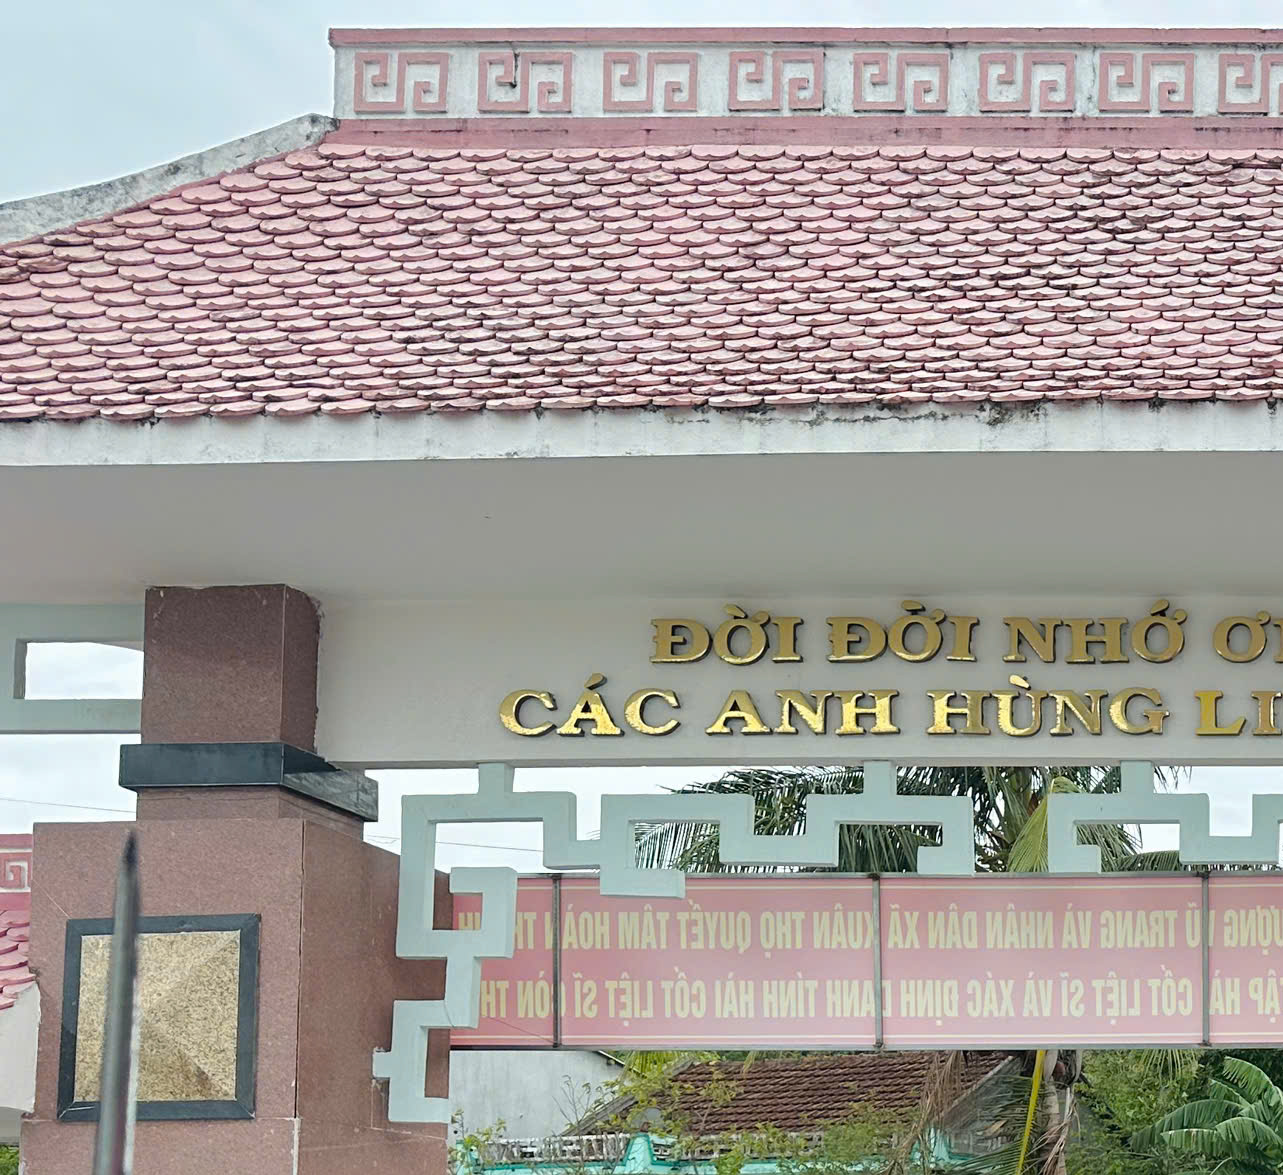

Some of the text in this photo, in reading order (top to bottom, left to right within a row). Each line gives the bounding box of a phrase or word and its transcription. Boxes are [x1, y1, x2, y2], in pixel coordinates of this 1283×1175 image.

[650, 604, 804, 666] ĐỜI
[827, 600, 980, 664] ĐỜI
[1002, 599, 1188, 664] NHỚ
[500, 672, 682, 737] CÁC
[705, 689, 902, 736] ANH
[926, 674, 1170, 738] HÙNG
